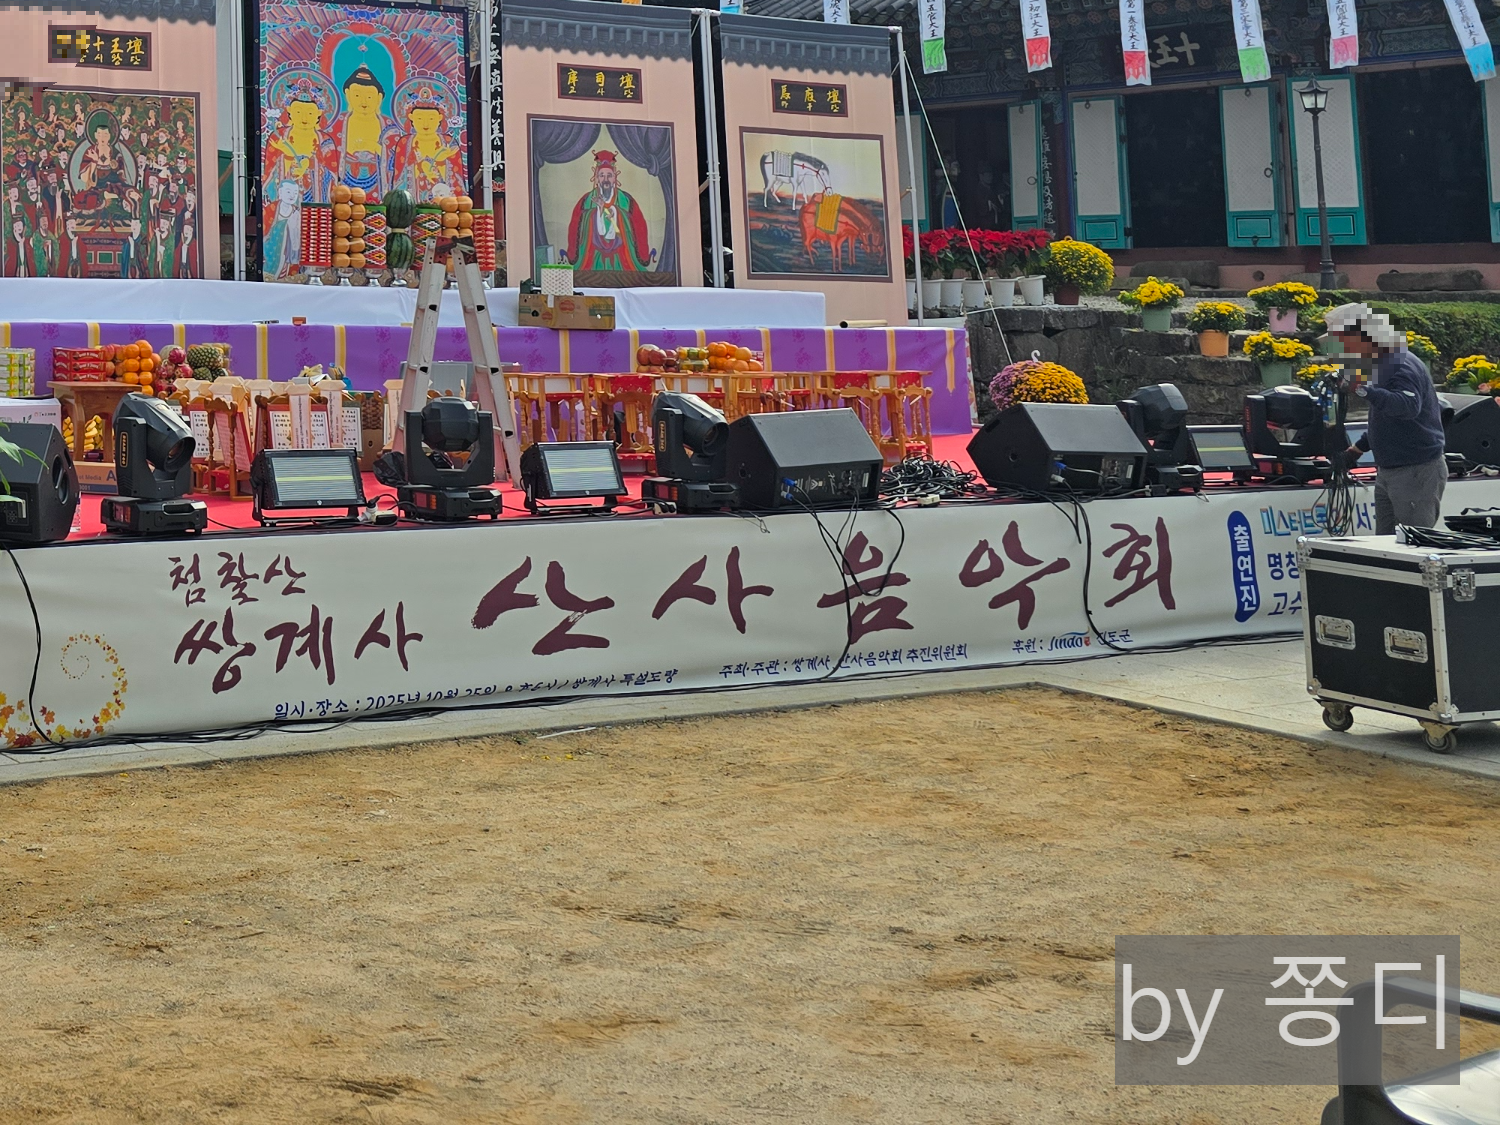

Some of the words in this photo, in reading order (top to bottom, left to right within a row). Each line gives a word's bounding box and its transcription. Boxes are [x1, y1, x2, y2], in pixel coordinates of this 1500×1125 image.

[168, 550, 307, 607] 첨찰산
[1233, 524, 1257, 613] 출연진
[173, 600, 424, 694] 쌍계사
[790, 656, 830, 673] 쌍계사
[906, 643, 969, 663] 추진위원회
[1011, 636, 1038, 654] 후원
